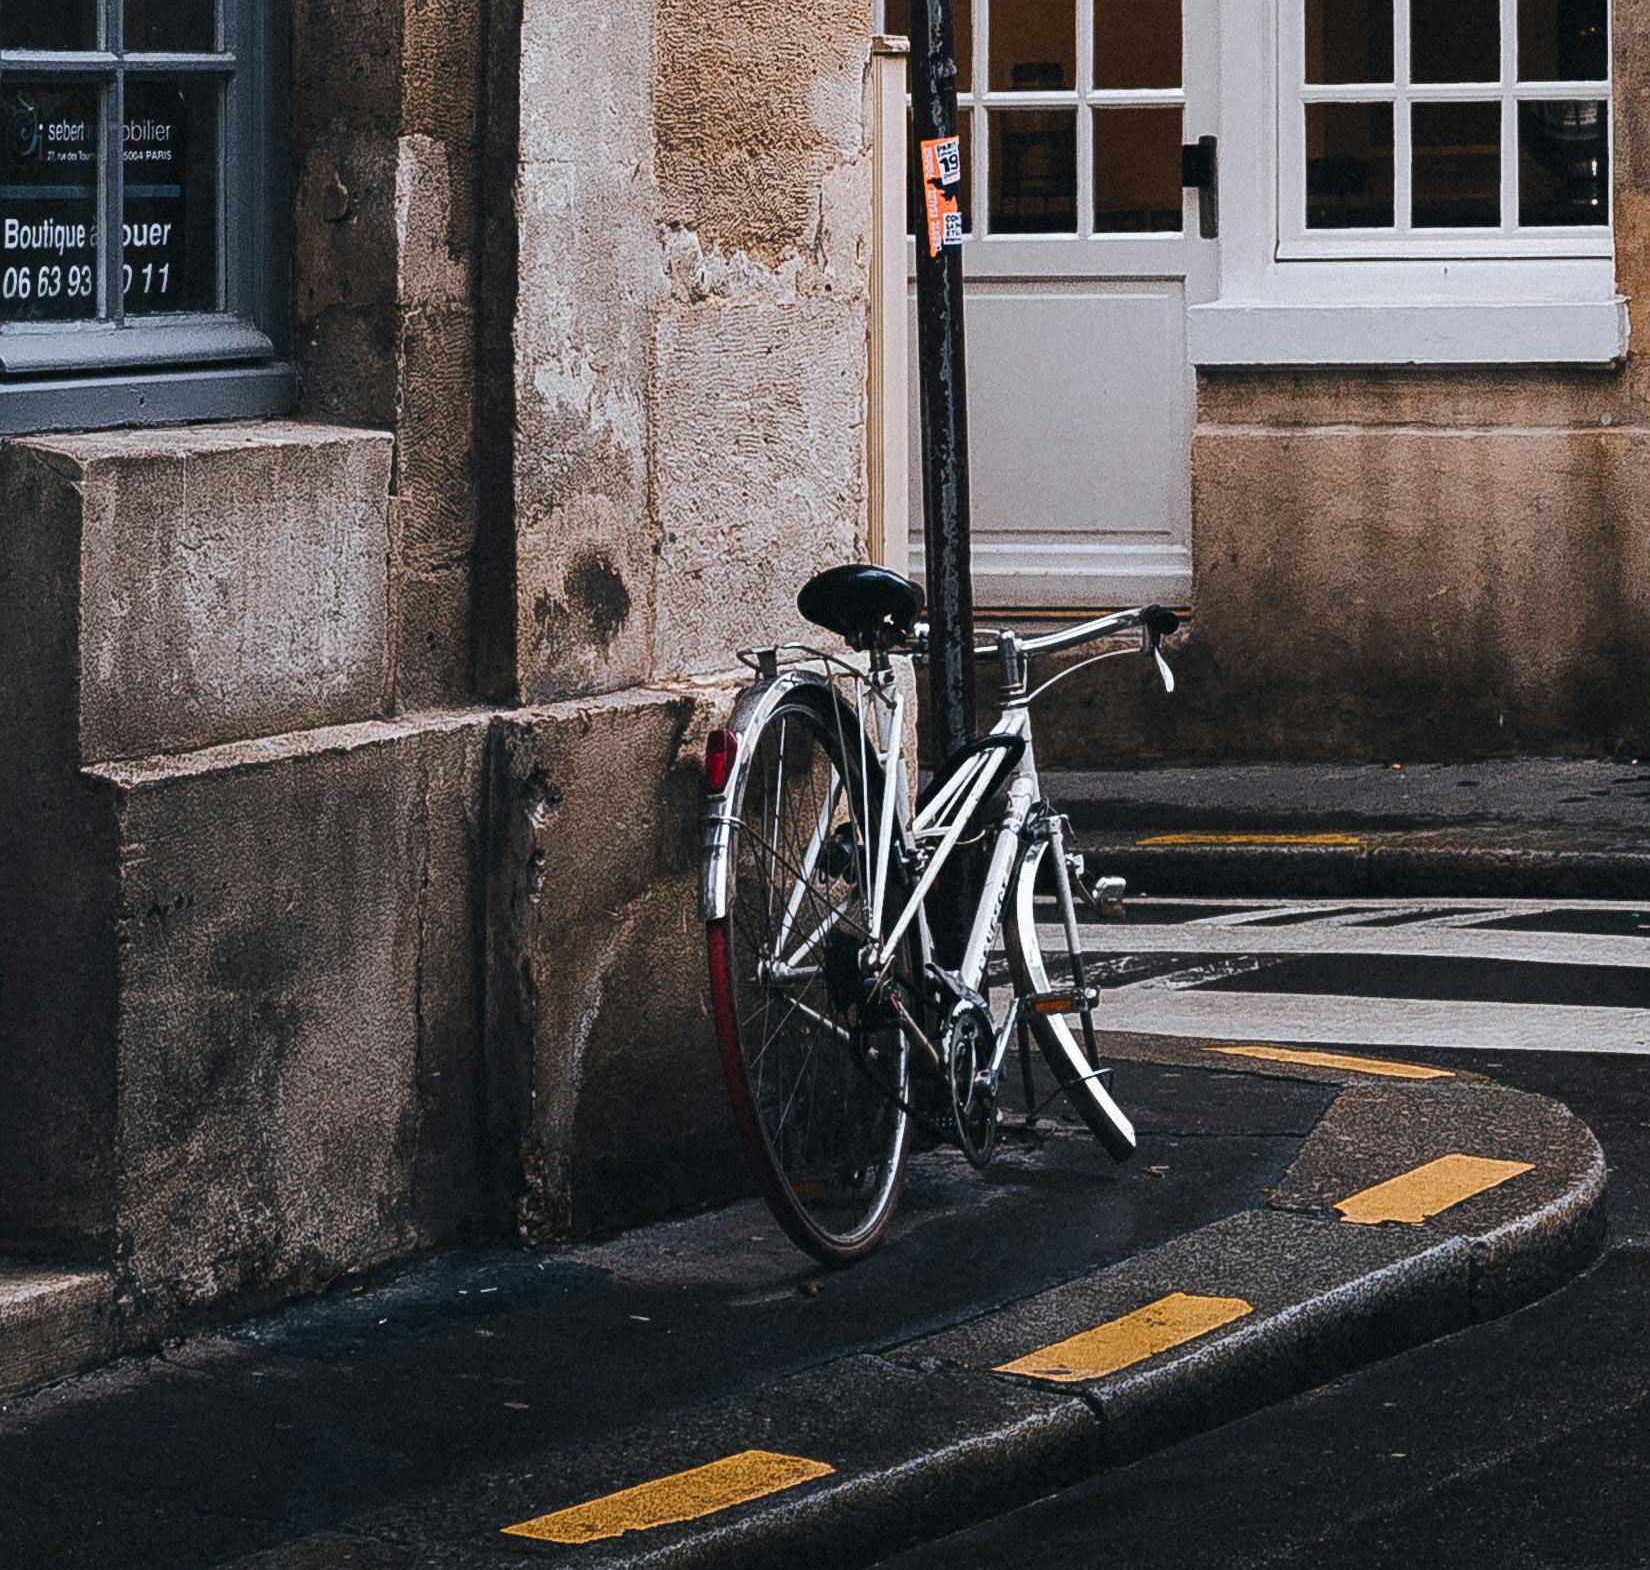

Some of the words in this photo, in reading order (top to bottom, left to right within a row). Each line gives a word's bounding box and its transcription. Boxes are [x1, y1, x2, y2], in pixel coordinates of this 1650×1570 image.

[48, 119, 84, 142] sebert
[122, 150, 144, 161] 5004
[146, 149, 172, 161] PARIS
[939, 154, 958, 172] 19
[4, 218, 86, 256] Boutique
[121, 223, 172, 247] ouer
[3, 266, 31, 299] 06
[37, 265, 62, 298] 63
[67, 265, 92, 297] 93
